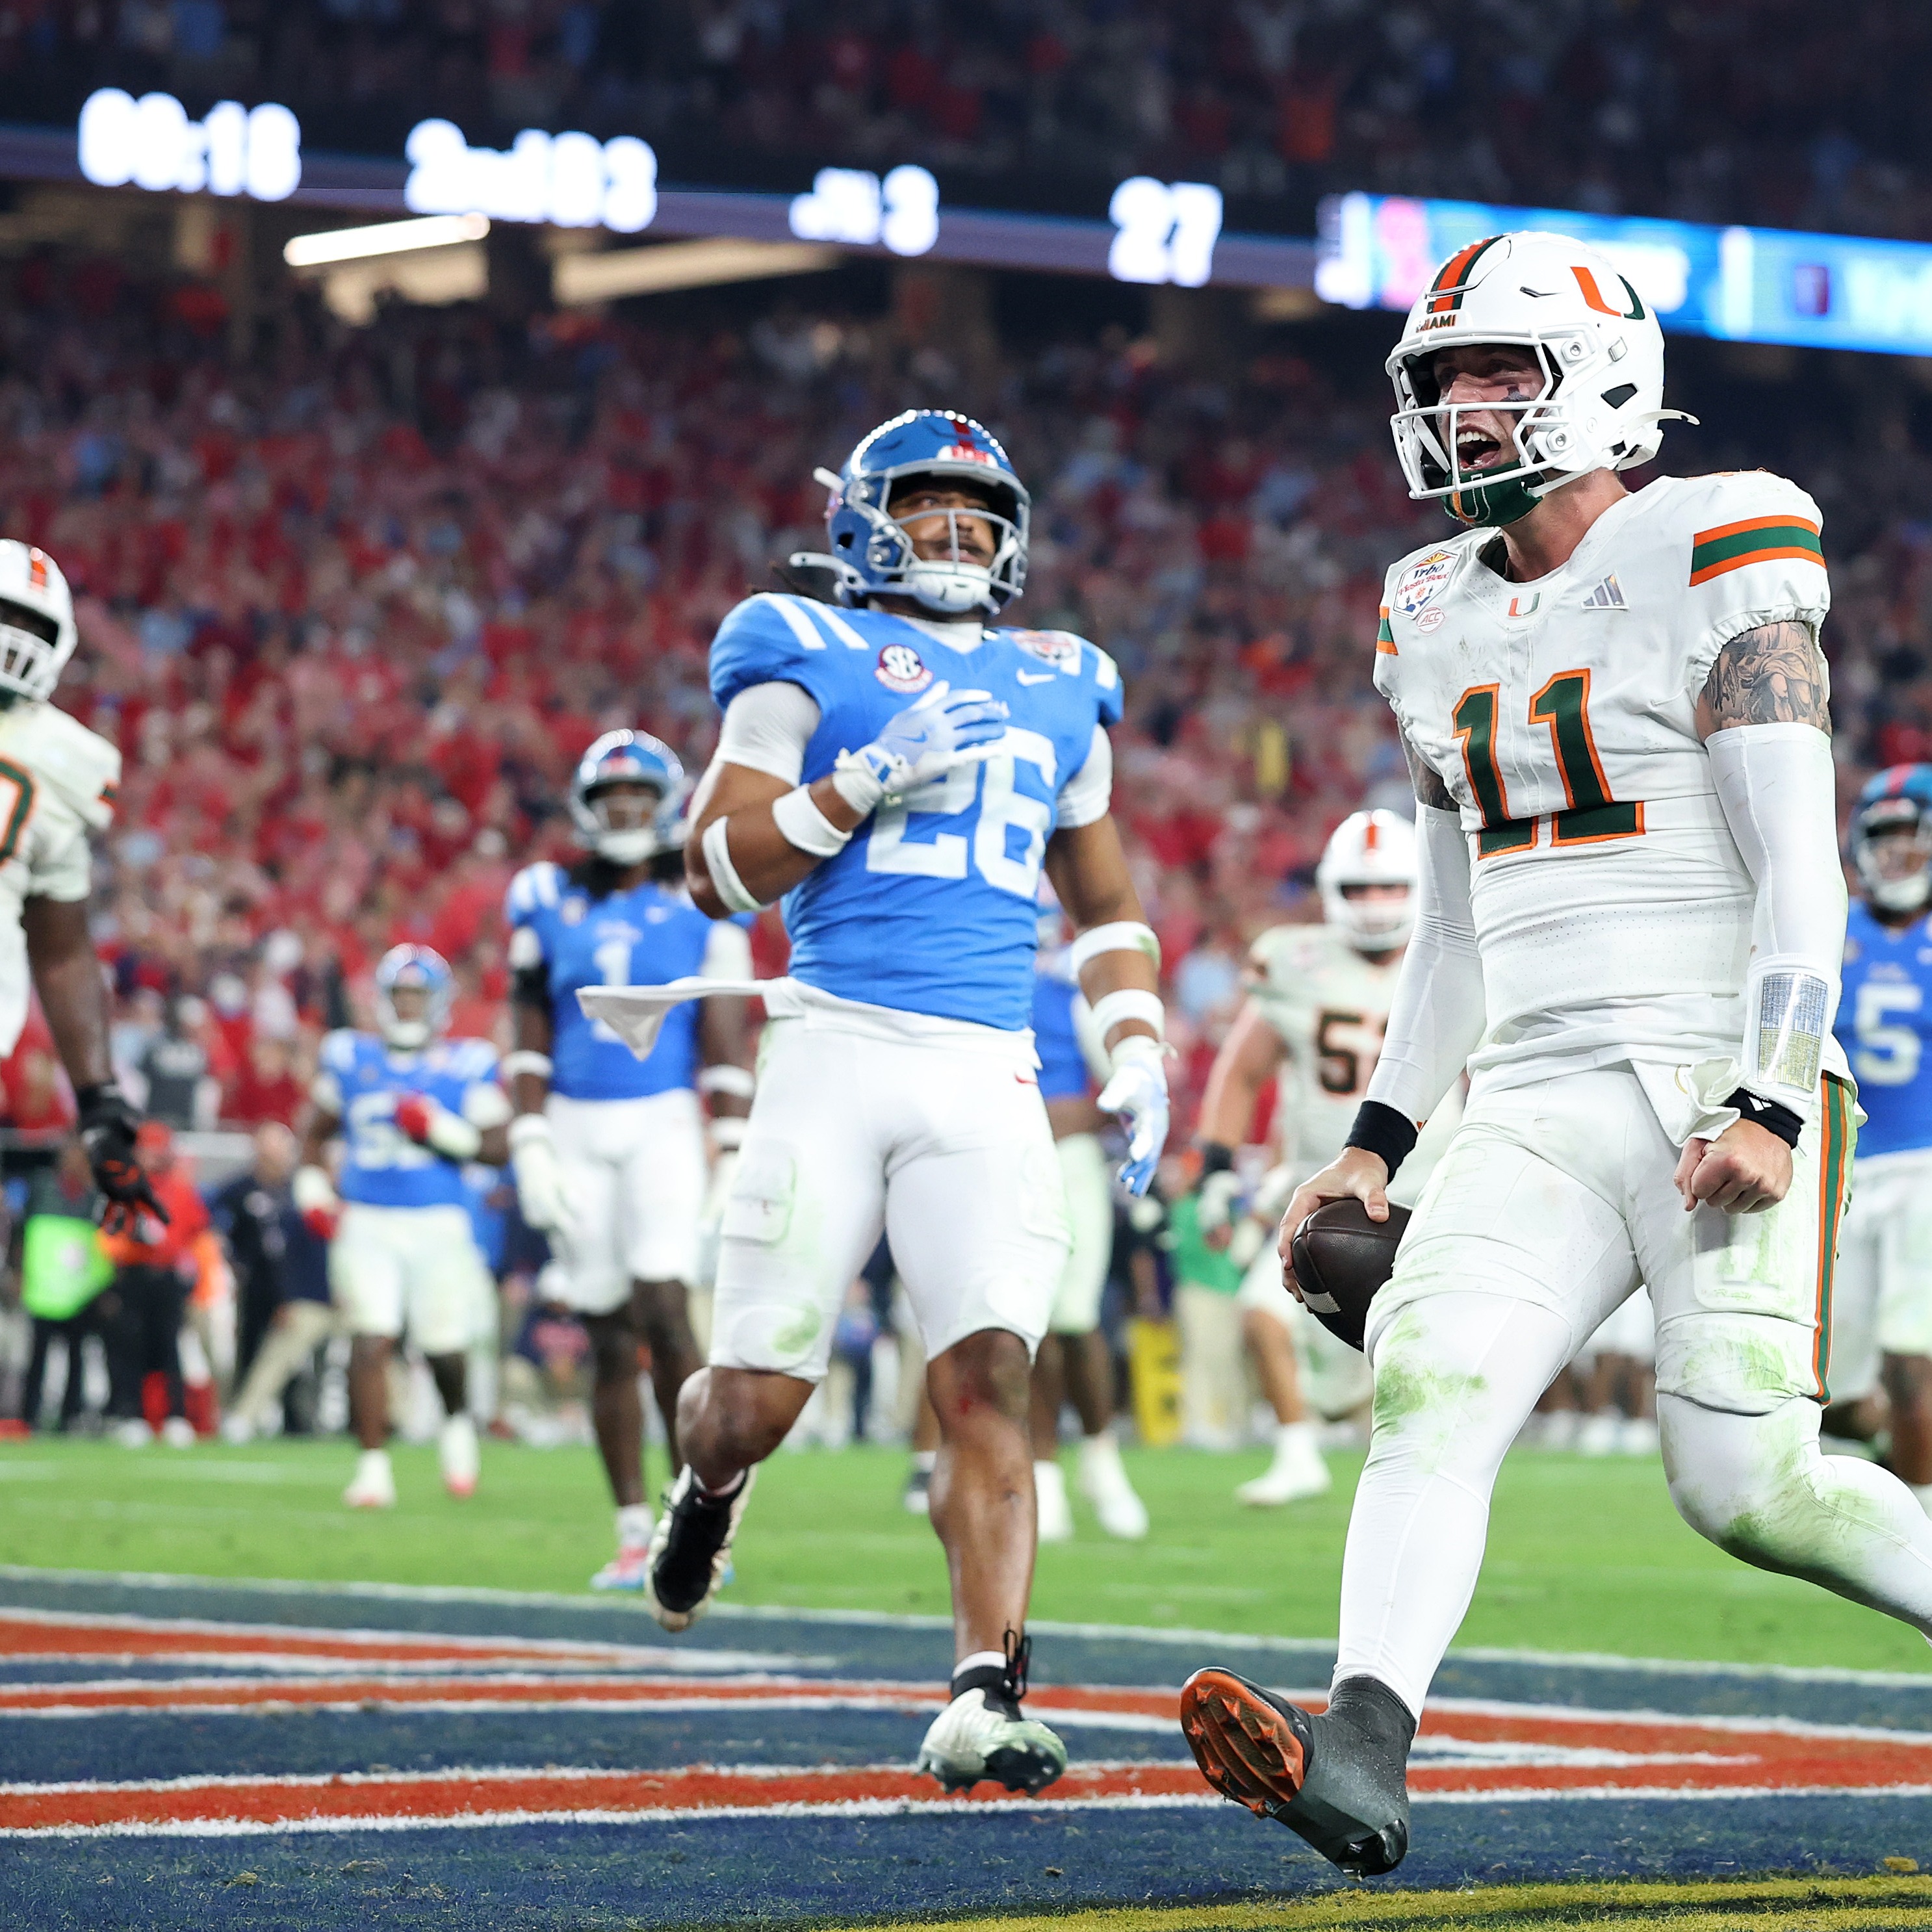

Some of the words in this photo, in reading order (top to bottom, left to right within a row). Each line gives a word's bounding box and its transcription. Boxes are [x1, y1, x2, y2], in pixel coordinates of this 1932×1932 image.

[1109, 175, 1223, 288] 27
[1420, 611, 1442, 625] ACC
[1508, 592, 1540, 617] U
[866, 725, 1057, 901] 26
[1451, 667, 1645, 861] 11
[1853, 979, 1924, 1087] 5
